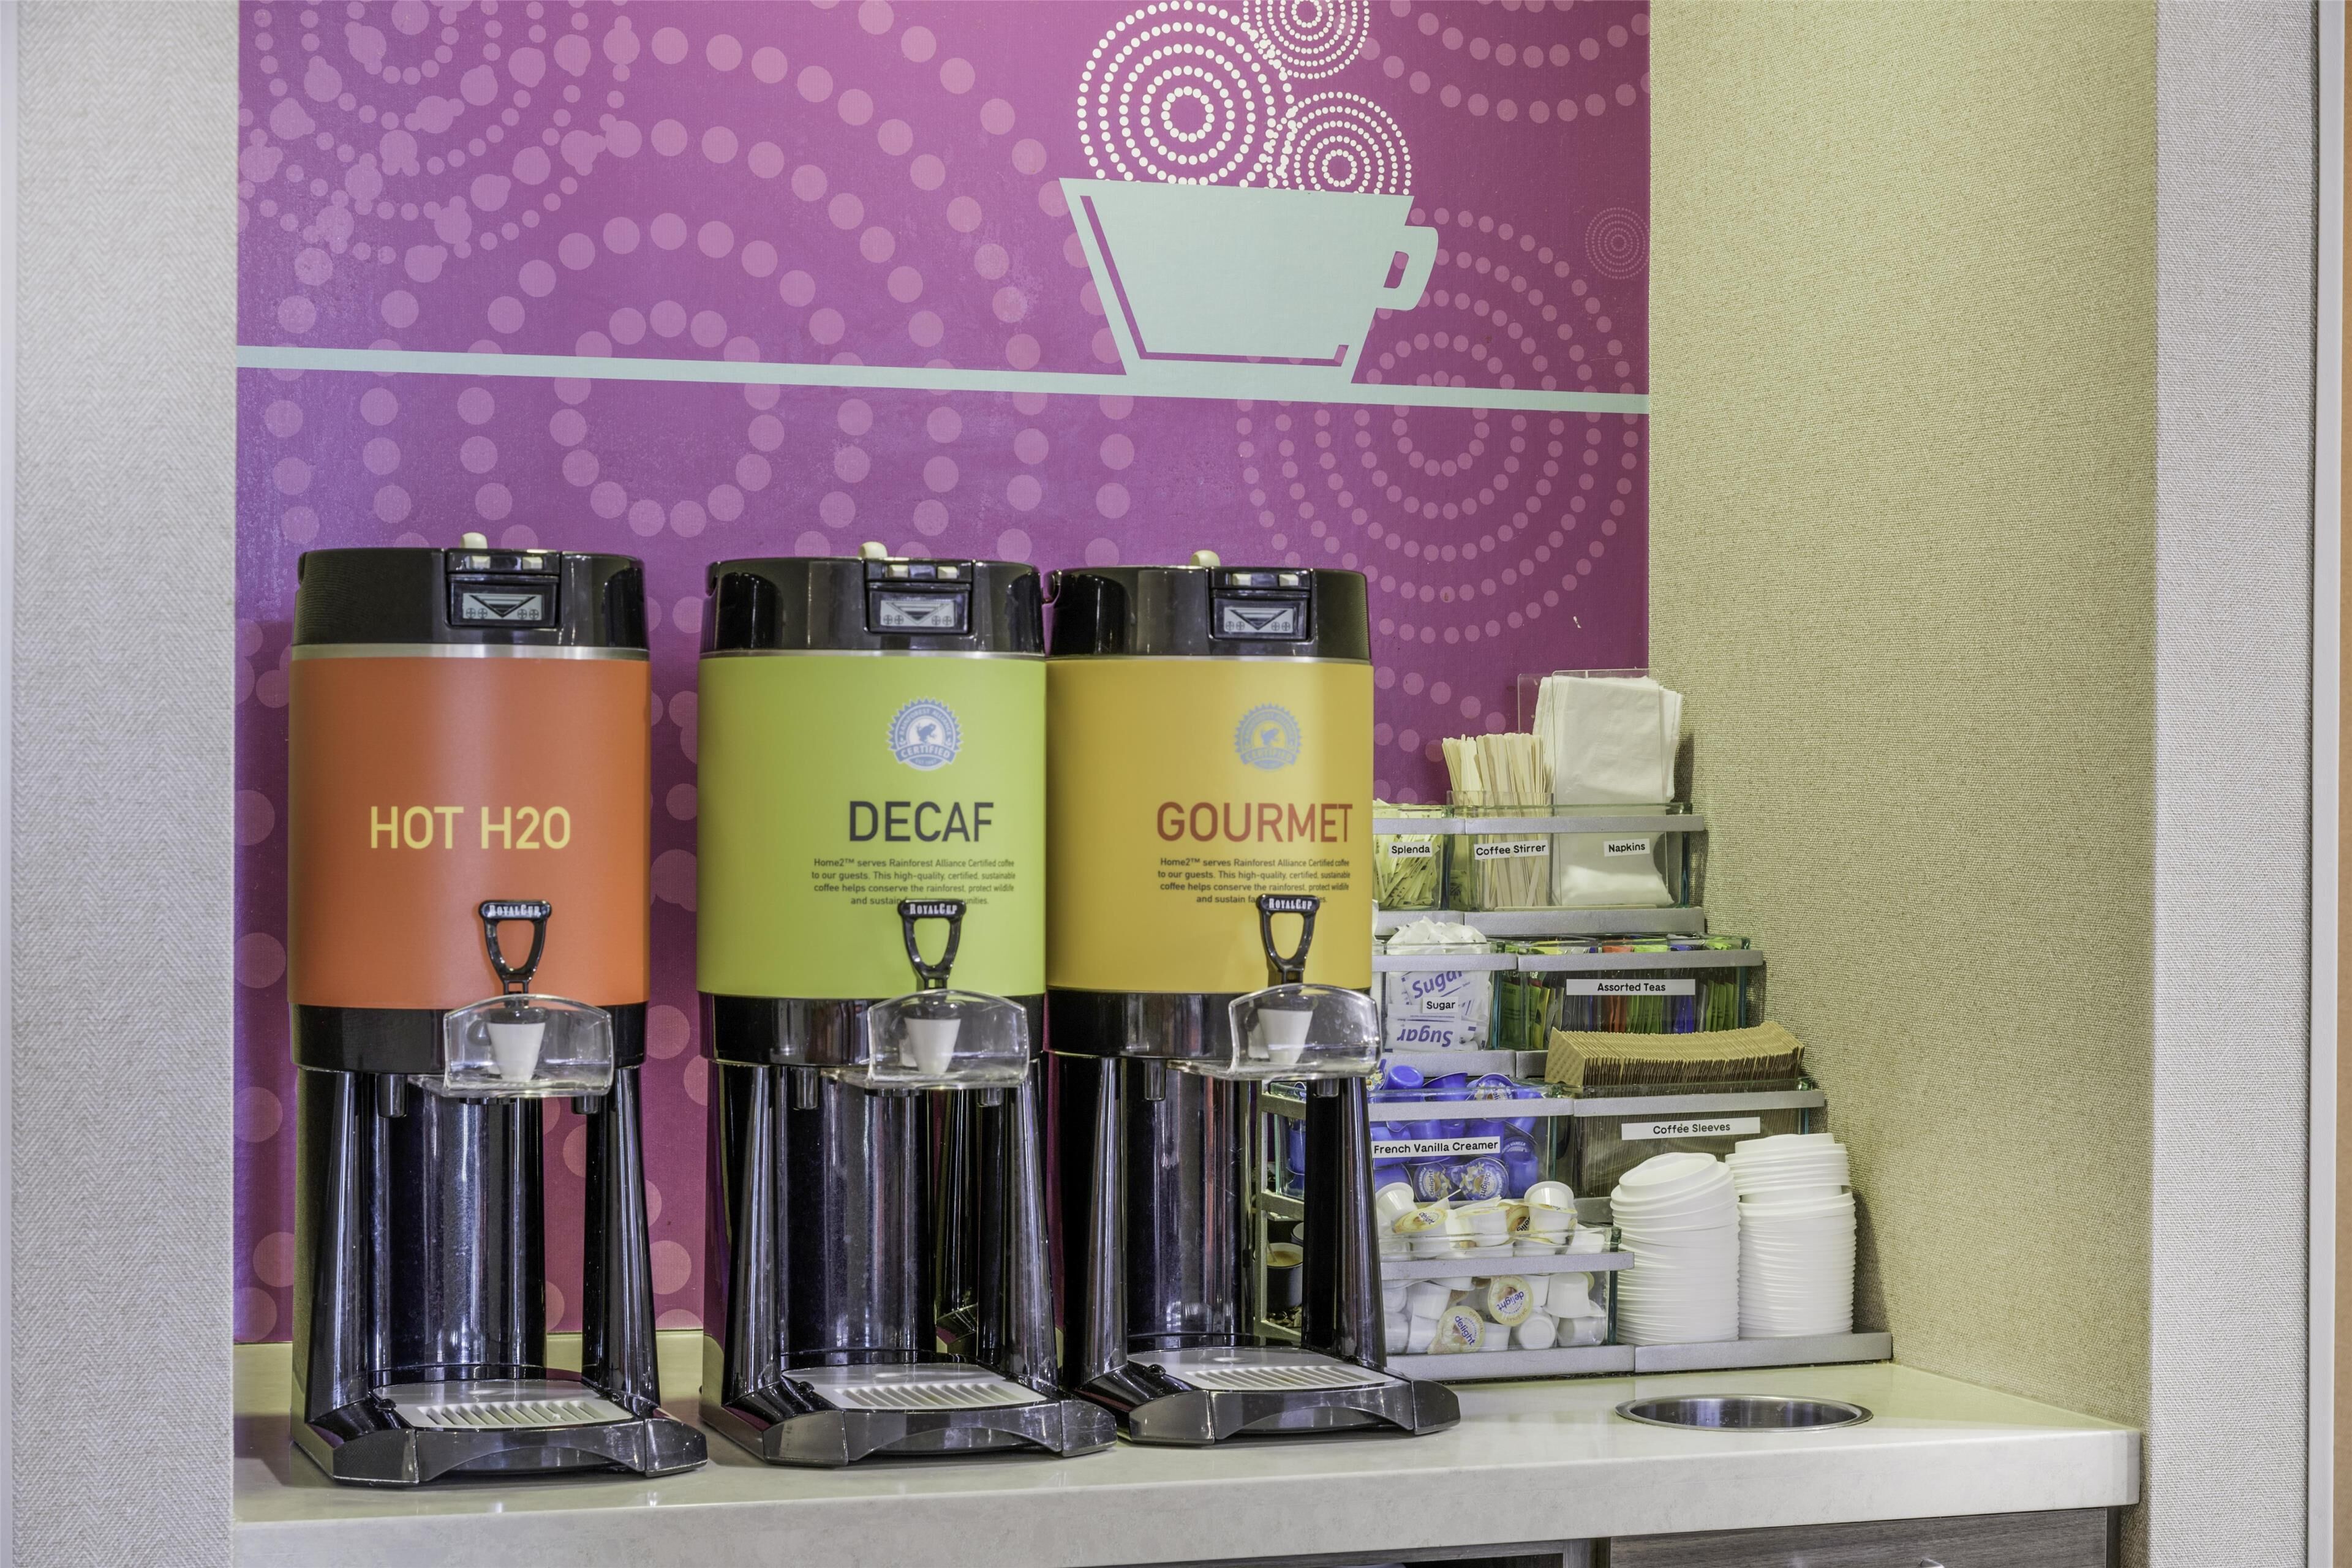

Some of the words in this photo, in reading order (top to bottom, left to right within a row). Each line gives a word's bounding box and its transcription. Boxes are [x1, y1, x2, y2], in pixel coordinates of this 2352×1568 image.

[901, 745, 951, 758] CERTIFIED
[849, 801, 994, 842] DECAF
[1157, 801, 1352, 843] GOURMET
[371, 806, 464, 850] HOT
[1391, 845, 1430, 855] Splenda
[1476, 846, 1510, 856] Coffee
[1513, 844, 1546, 853] Stirrer
[1608, 842, 1645, 853] Napkins
[889, 859, 933, 867] Rainforest
[935, 859, 966, 867] Alliance
[968, 859, 996, 867] Certified
[998, 859, 1015, 867] coffee
[1234, 858, 1275, 867] Rainforest
[1278, 859, 1306, 867] Alliance
[1308, 859, 1333, 867] Certified
[839, 872, 870, 881] guests.
[873, 871, 891, 880] This
[982, 871, 1016, 880] sustainable
[1185, 871, 1215, 880] guests.
[1218, 870, 1235, 878] This
[814, 883, 839, 892] coffee
[842, 883, 866, 894] helps
[911, 884, 924, 892] the
[968, 884, 992, 893] protect
[993, 883, 1014, 892] wildlife
[1160, 882, 1185, 891] coffee
[1188, 883, 1212, 892] helps
[1308, 883, 1330, 892] protect
[1597, 982, 1641, 992] Assorted
[1644, 982, 1666, 992] Teas
[1426, 1000, 1456, 1011] Sugar
[1396, 1025, 1453, 1047] Sugar
[1653, 1125, 1689, 1134] Coffee
[1692, 1123, 1730, 1133] Sleeves
[1374, 1144, 1411, 1154] French
[1414, 1142, 1450, 1153] Vanilla
[1452, 1141, 1498, 1151] Creamer
[1480, 1171, 1491, 1197] delight
[1496, 1291, 1525, 1312] delight
[1455, 1315, 1476, 1346] delight
